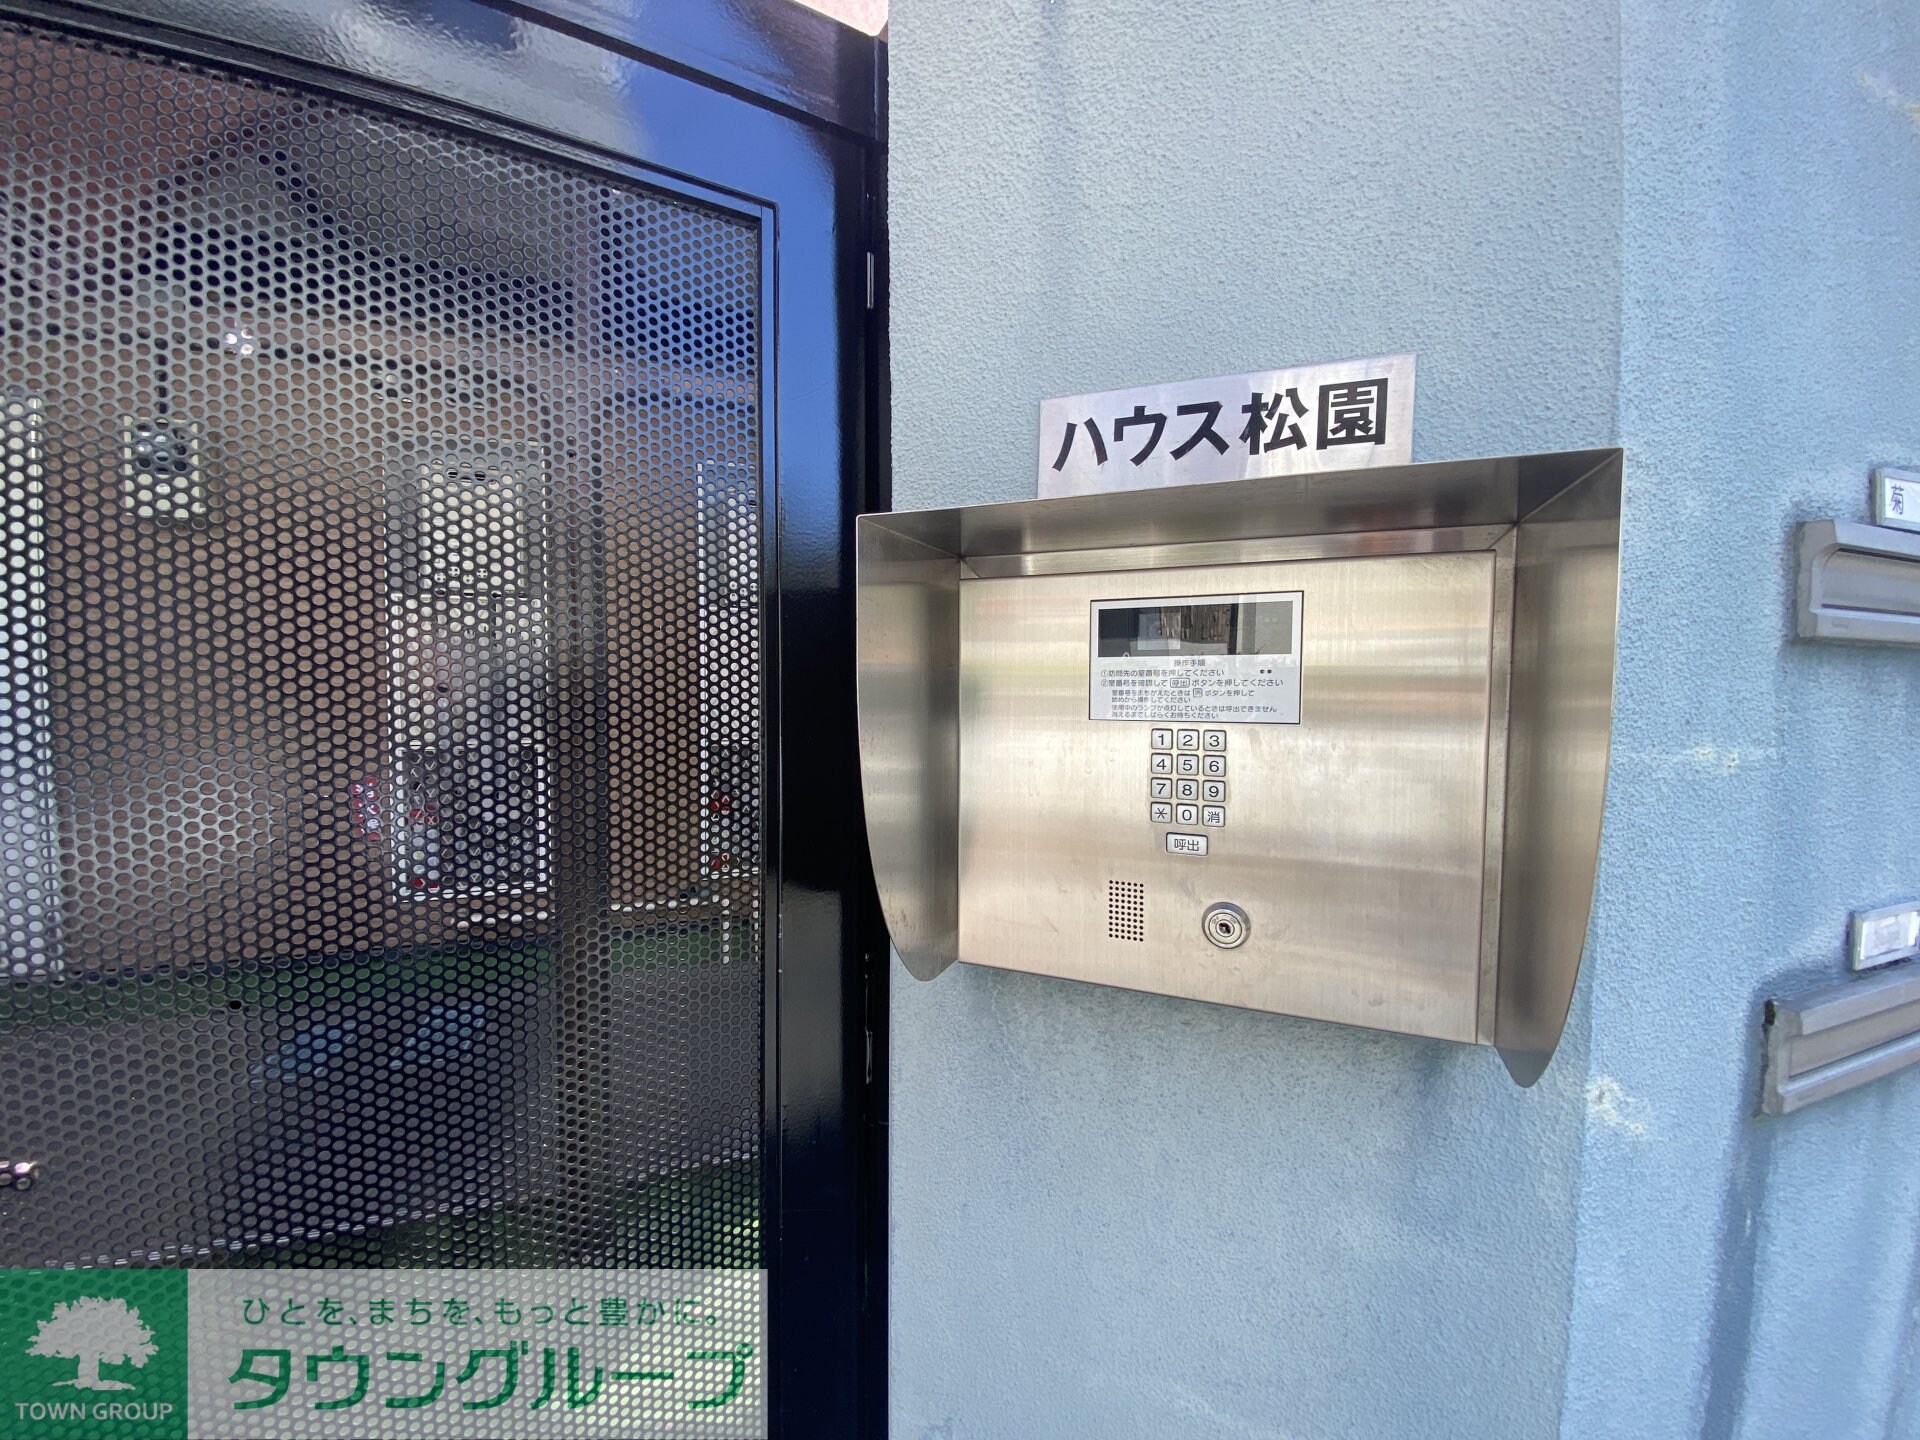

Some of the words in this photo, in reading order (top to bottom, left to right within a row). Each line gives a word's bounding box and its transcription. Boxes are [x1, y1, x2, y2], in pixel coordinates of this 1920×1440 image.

[1052, 377, 1389, 472] ハウス松園
[1158, 734, 1164, 746] 1
[1182, 734, 1193, 746] 2
[1209, 735, 1220, 747] 3
[1156, 758, 1166, 770] 4
[1182, 760, 1192, 771] 5
[1209, 760, 1219, 773] 6
[1156, 783, 1166, 795] 7
[1182, 784, 1192, 796] 8
[1209, 786, 1219, 798] 9
[1207, 811, 1220, 823] 消
[1174, 838, 1199, 851] 呼出
